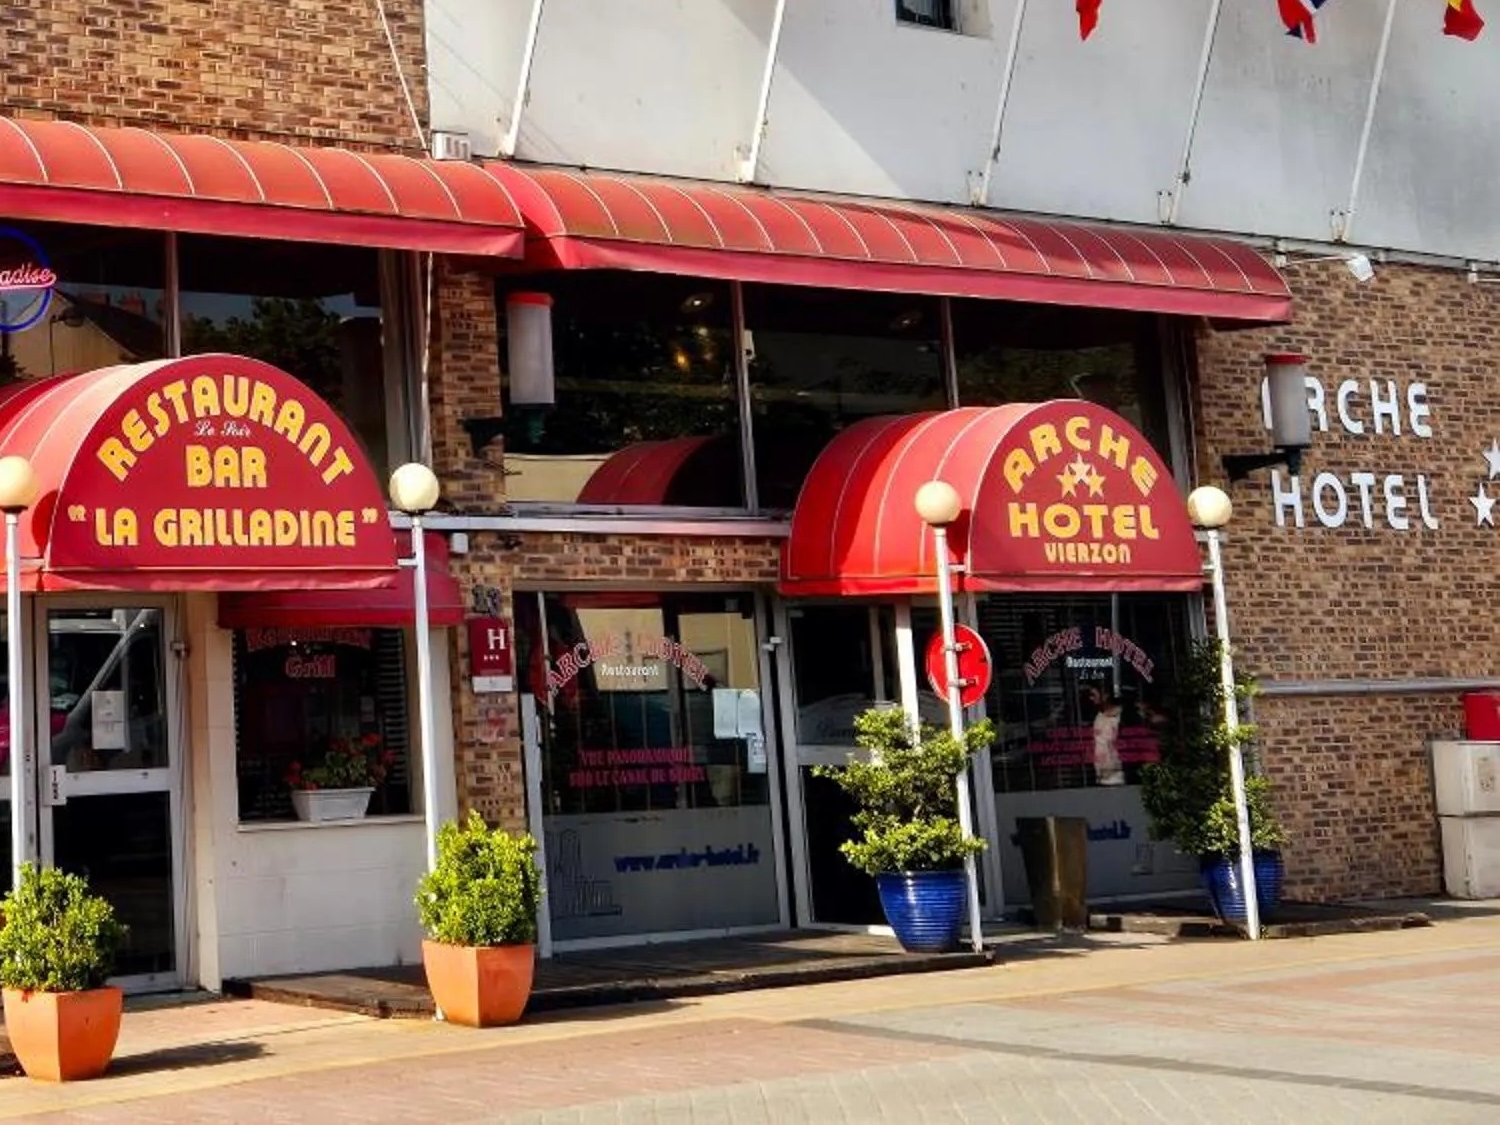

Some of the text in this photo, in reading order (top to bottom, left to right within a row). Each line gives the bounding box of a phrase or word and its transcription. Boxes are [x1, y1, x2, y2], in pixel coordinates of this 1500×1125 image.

[96, 375, 355, 486] RESTAURANT
[1261, 376, 1433, 438] RCHE
[185, 445, 268, 488] BAR
[1003, 416, 1159, 495] ARCHE
[1009, 502, 1160, 540] HOTEL
[1271, 469, 1439, 530] HOTEL
[1044, 542, 1131, 564] VIERZON
[487, 628, 507, 650] H
